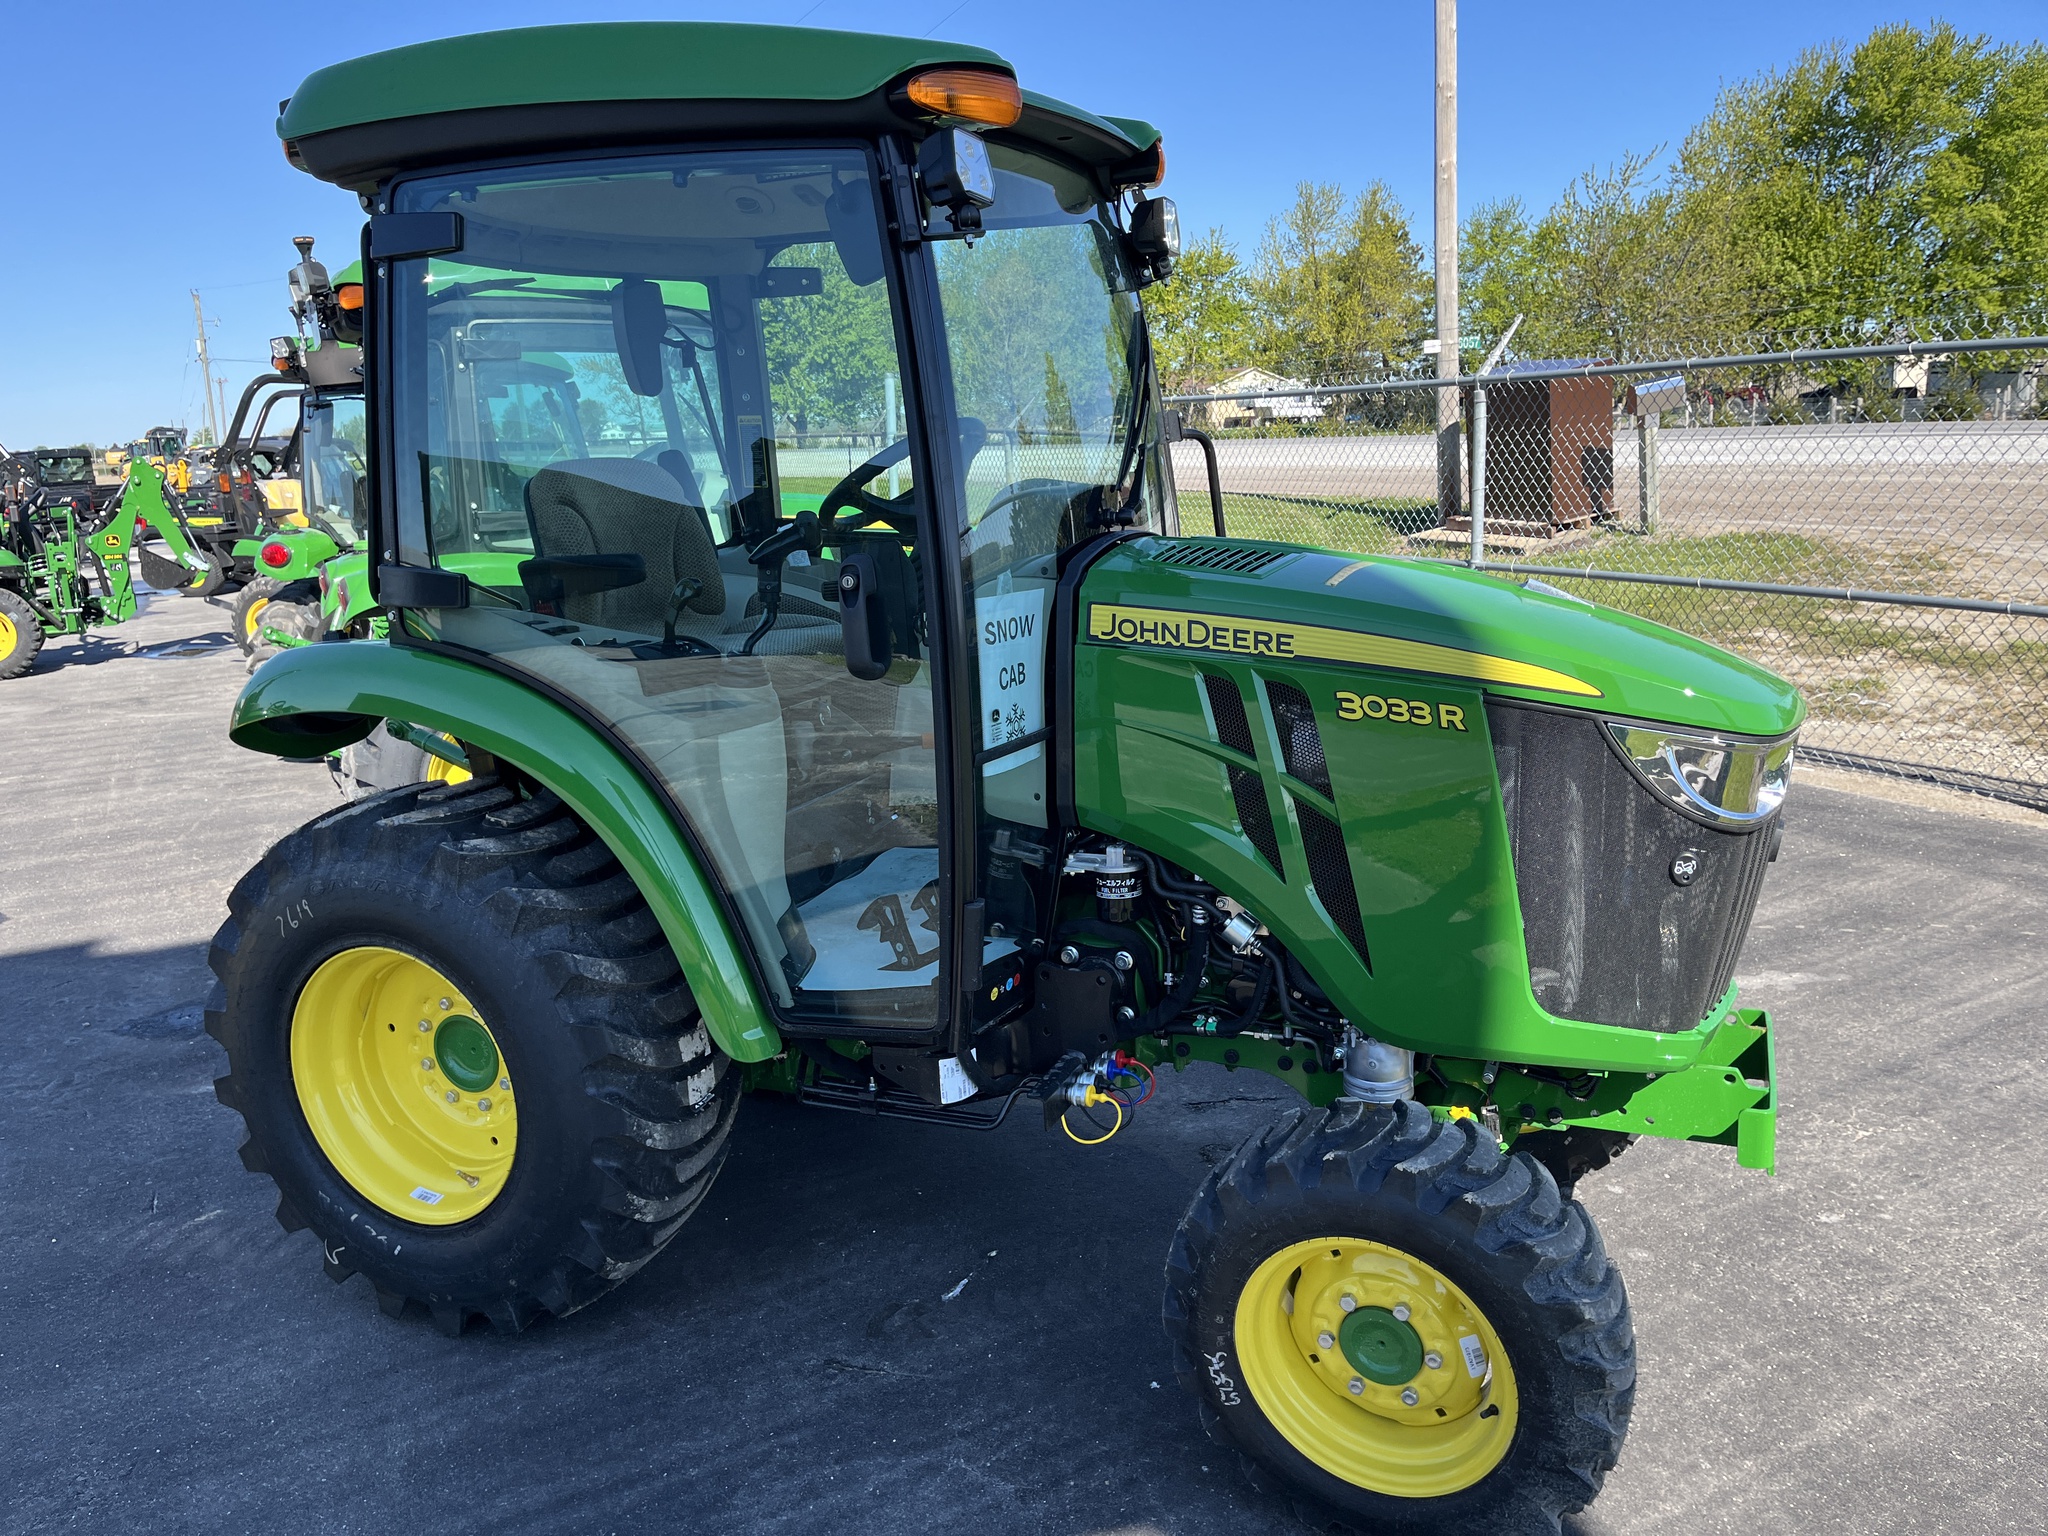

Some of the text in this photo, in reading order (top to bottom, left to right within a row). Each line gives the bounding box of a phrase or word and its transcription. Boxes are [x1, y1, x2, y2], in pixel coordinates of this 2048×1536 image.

[984, 613, 1035, 646] SNOW
[1100, 612, 1296, 656] JOHN DEERE
[999, 662, 1026, 691] CAB
[275, 898, 314, 939] 7619
